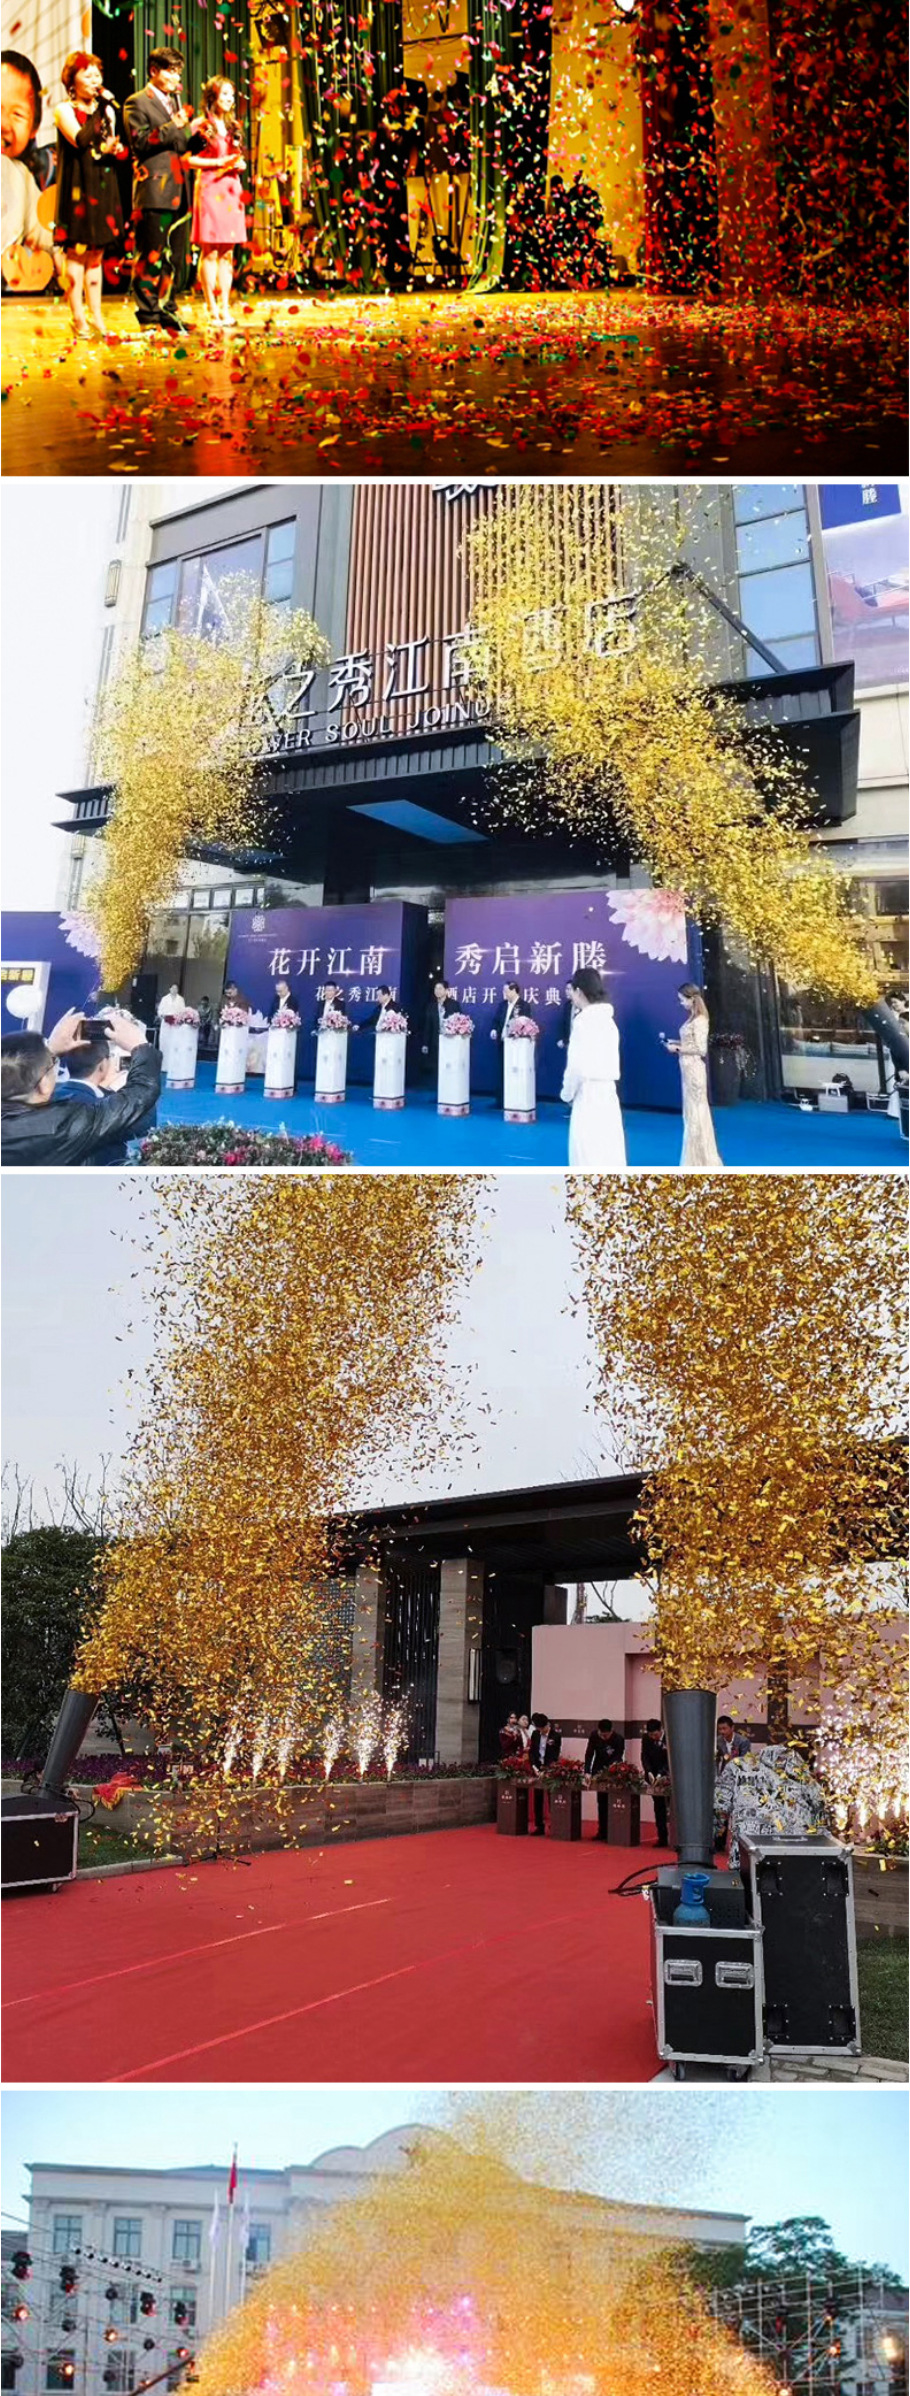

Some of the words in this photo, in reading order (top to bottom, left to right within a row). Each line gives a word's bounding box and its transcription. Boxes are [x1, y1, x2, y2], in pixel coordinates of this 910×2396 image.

[242, 590, 641, 732] 之秀江南酒店
[324, 714, 394, 743] SOUL
[407, 695, 491, 729] JOINU
[268, 946, 385, 976] 花开江南
[447, 985, 562, 1006] 酒店开庆典
